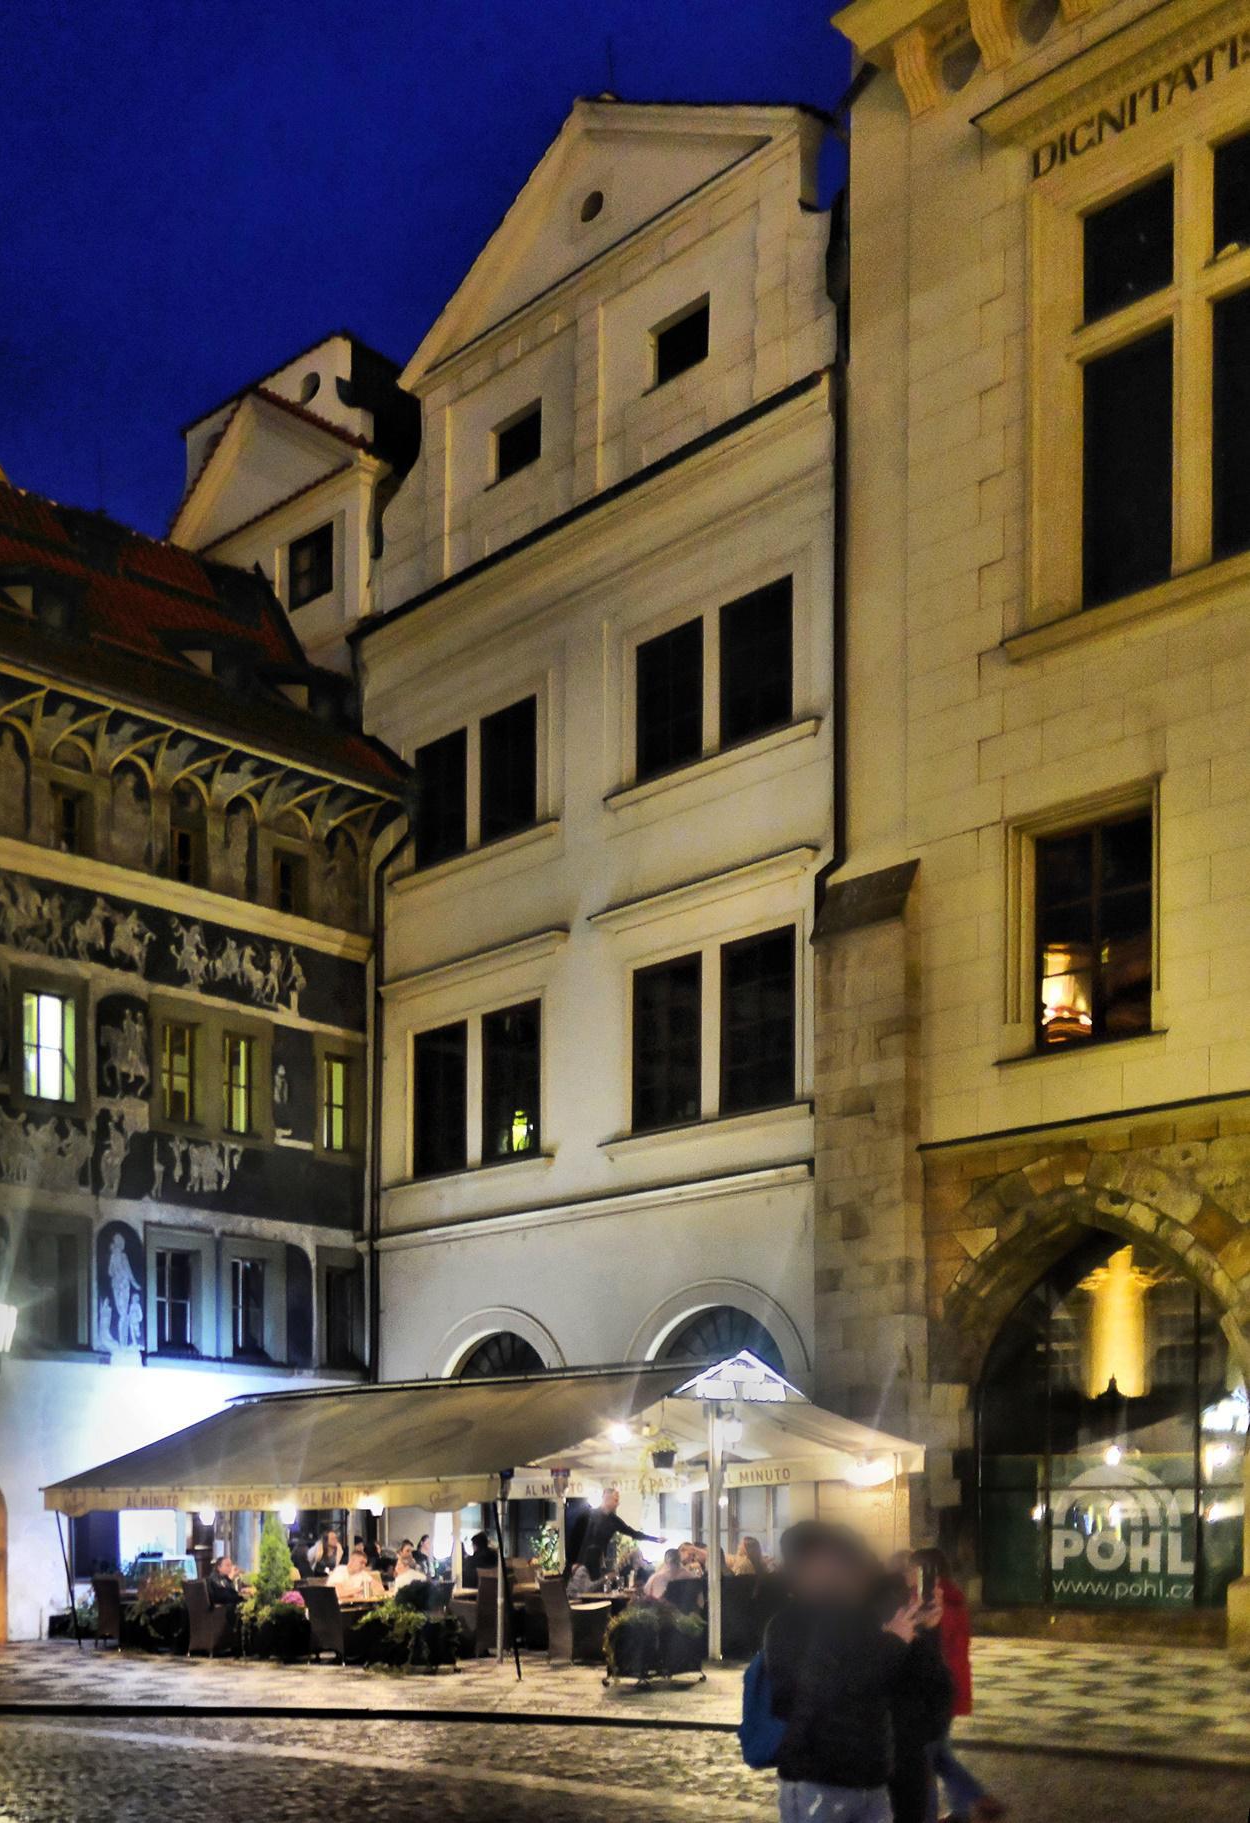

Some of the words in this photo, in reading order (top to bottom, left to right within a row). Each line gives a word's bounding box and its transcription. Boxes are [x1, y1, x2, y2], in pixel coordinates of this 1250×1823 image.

[541, 1482, 583, 1495] MITO
[739, 1467, 791, 1483] MINUTO
[1051, 1529, 1195, 1575] POHL
[1052, 1578, 1195, 1600] www.pohl.cz
